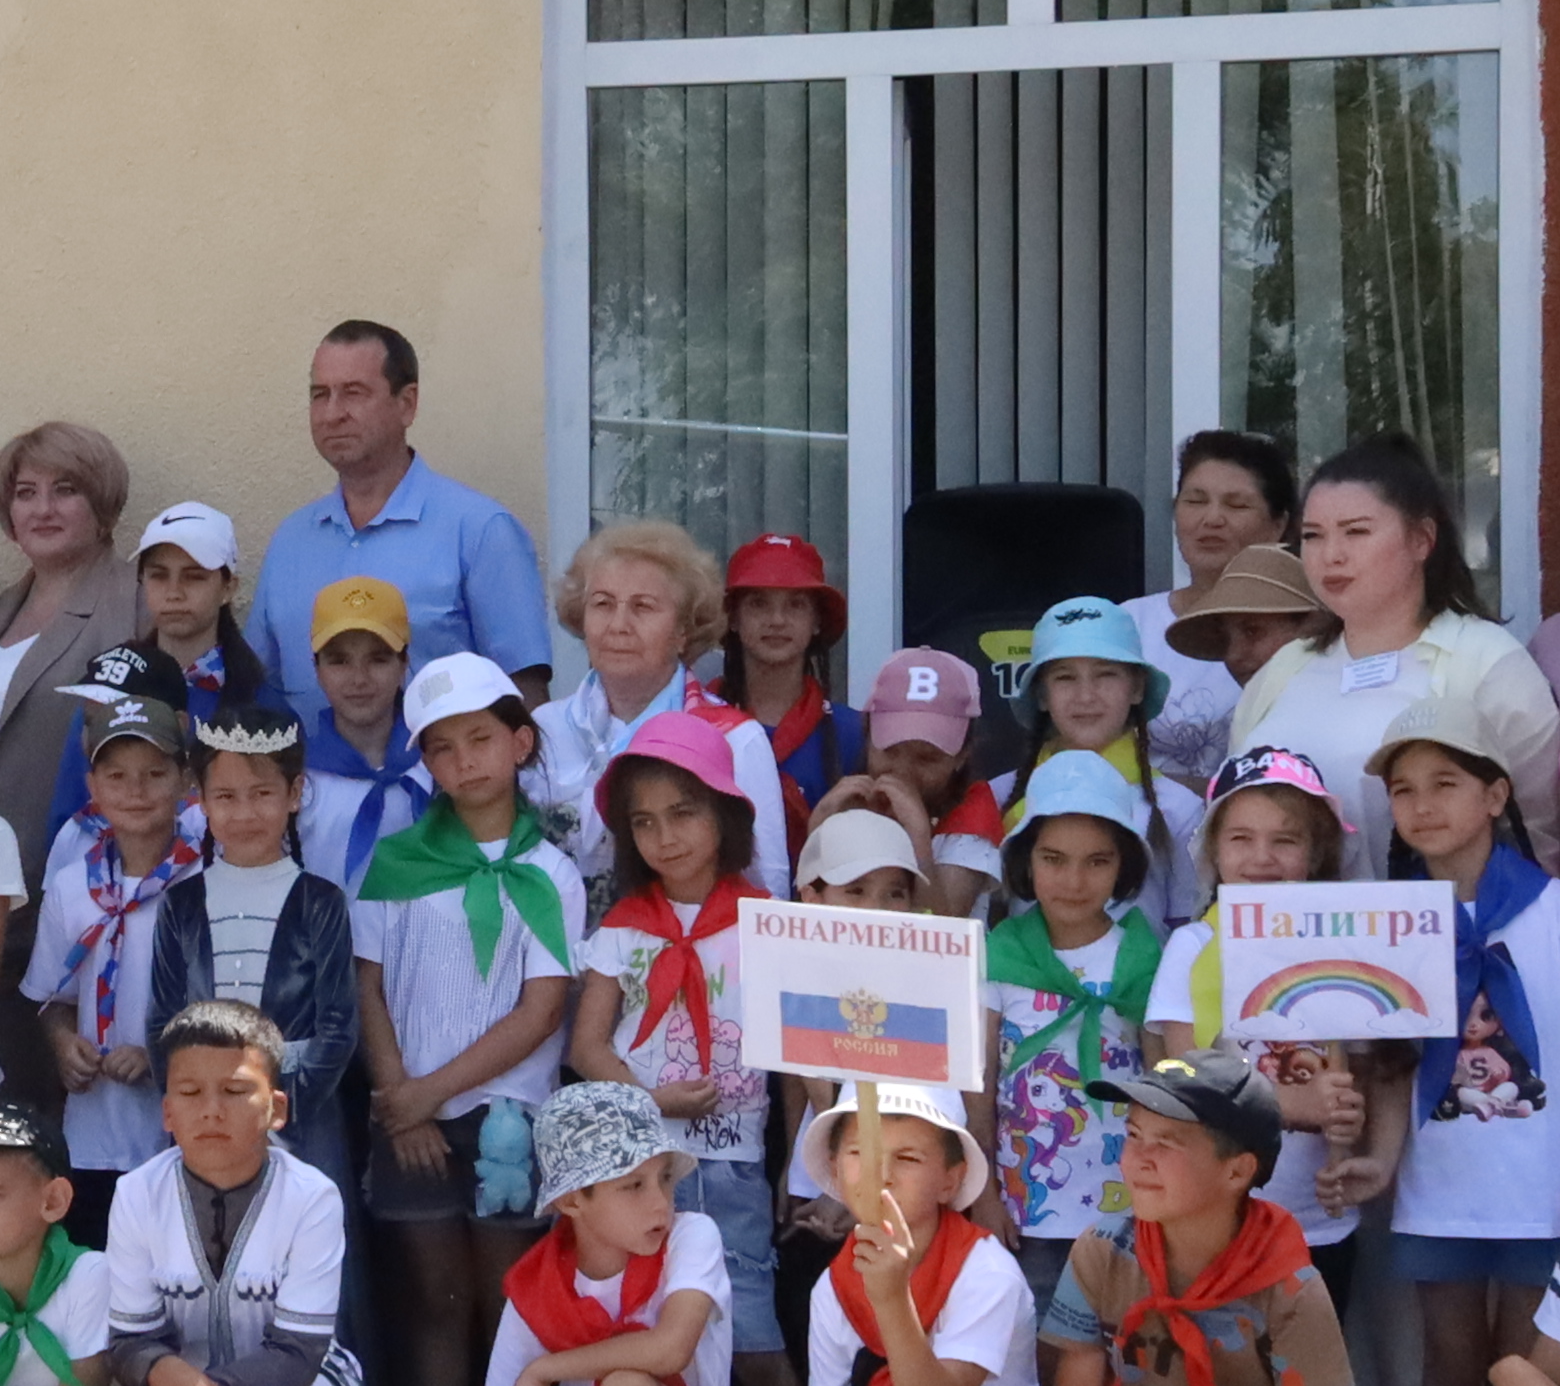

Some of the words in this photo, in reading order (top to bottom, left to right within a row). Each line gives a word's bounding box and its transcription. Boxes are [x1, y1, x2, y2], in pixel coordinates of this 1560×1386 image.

[94, 659, 131, 686] 39
[906, 666, 939, 702] B
[754, 912, 972, 958] ЮНАРМЕЙЦЫ
[1228, 902, 1443, 947] Палитра
[832, 1037, 899, 1057] РОССИЯ
[1470, 1057, 1488, 1079] S
